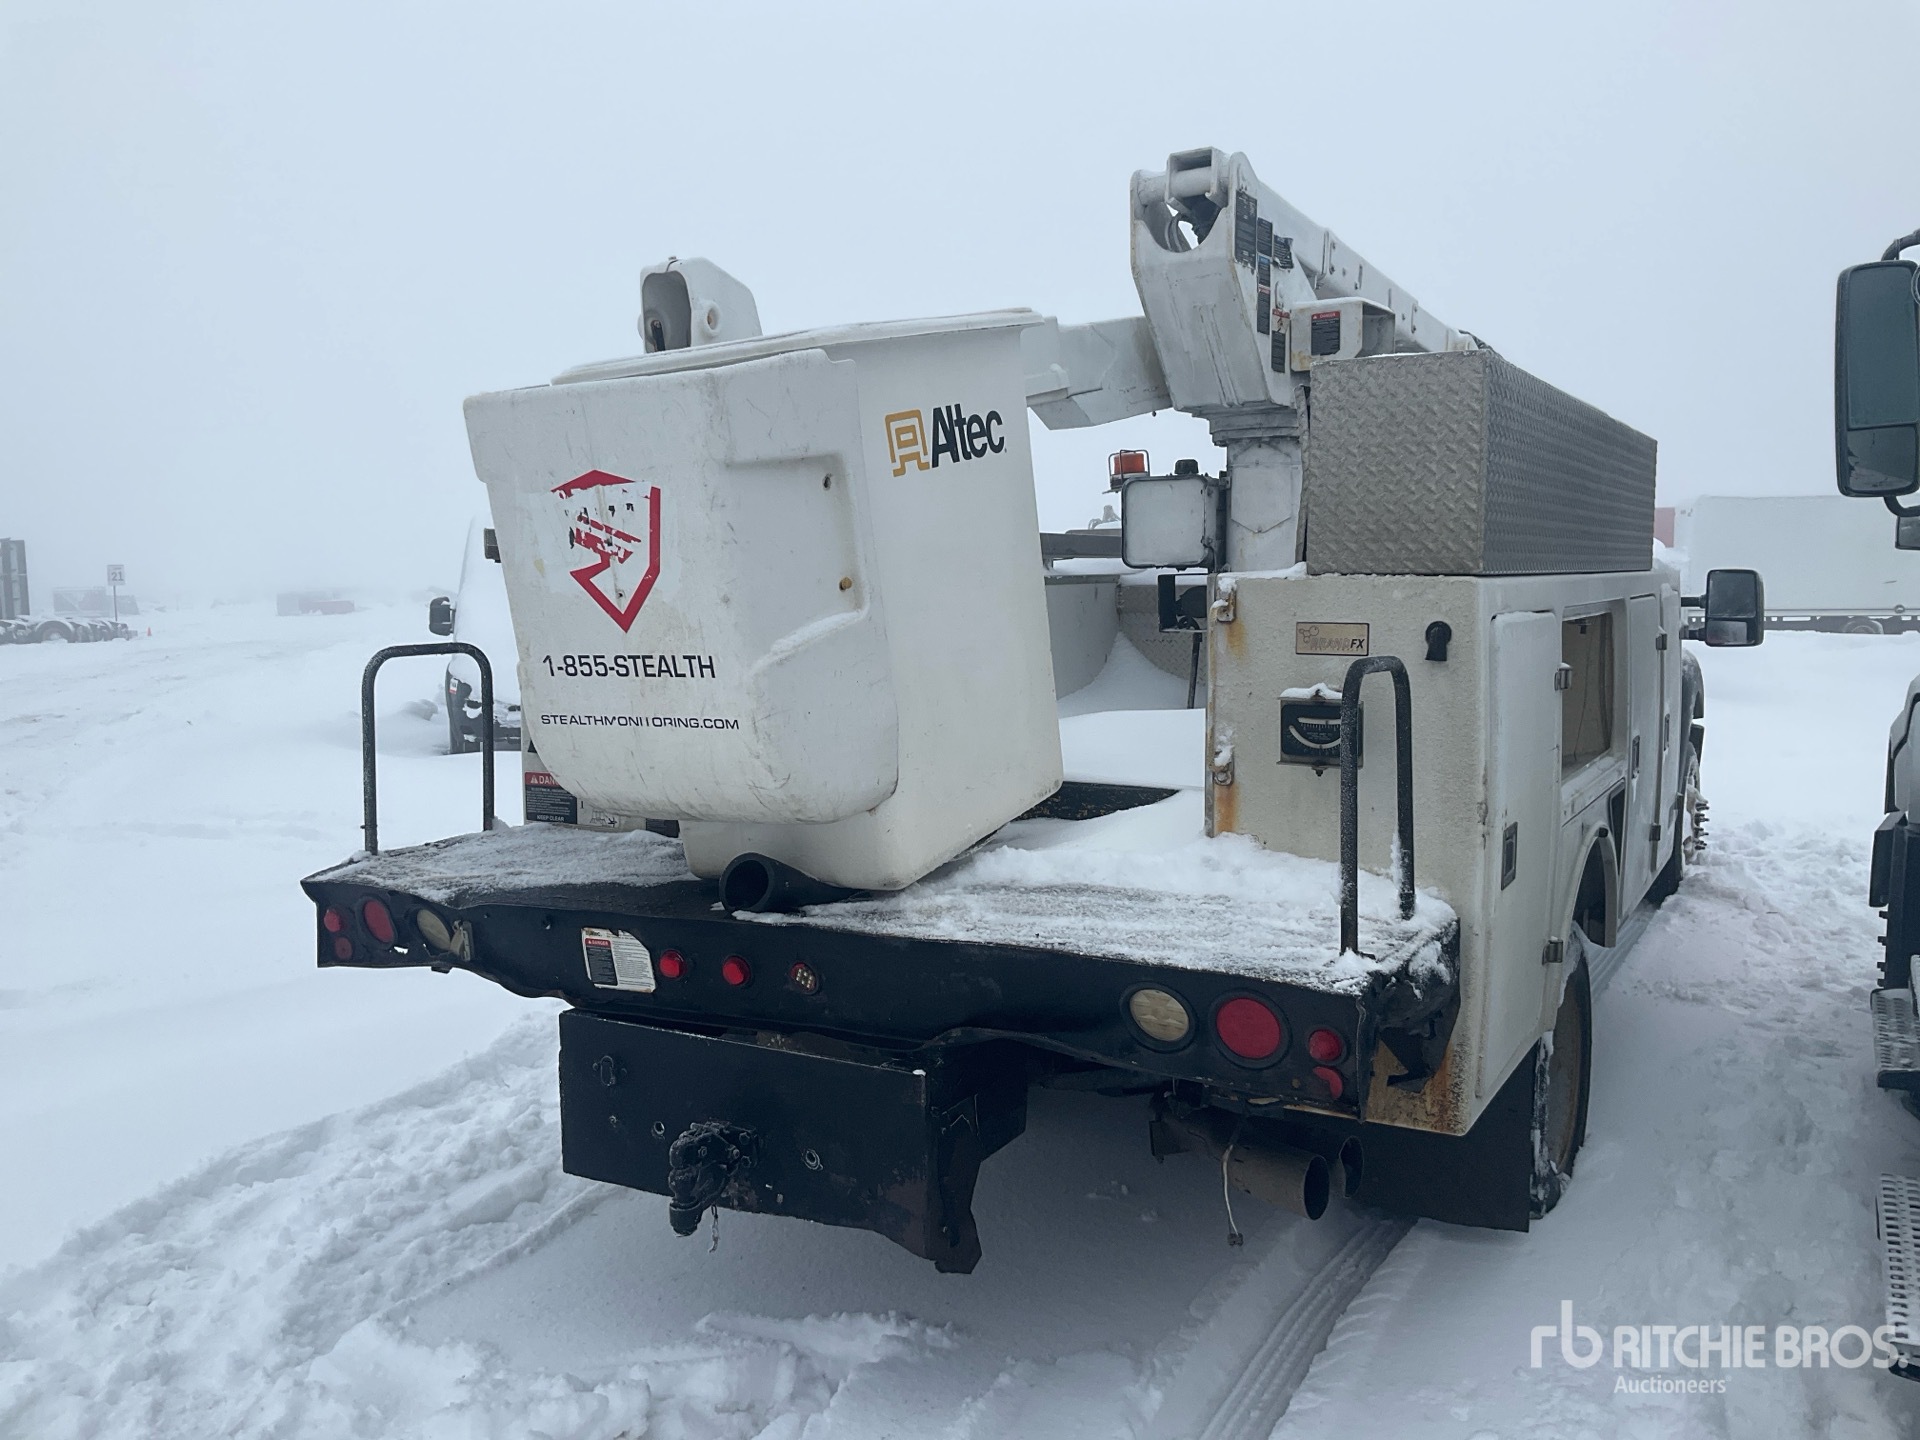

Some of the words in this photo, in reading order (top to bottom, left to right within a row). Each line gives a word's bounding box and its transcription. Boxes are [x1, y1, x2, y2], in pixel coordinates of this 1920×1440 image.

[931, 403, 1005, 468] Altec
[111, 571, 124, 581] 21
[542, 654, 716, 679] 1-855-STEALTH
